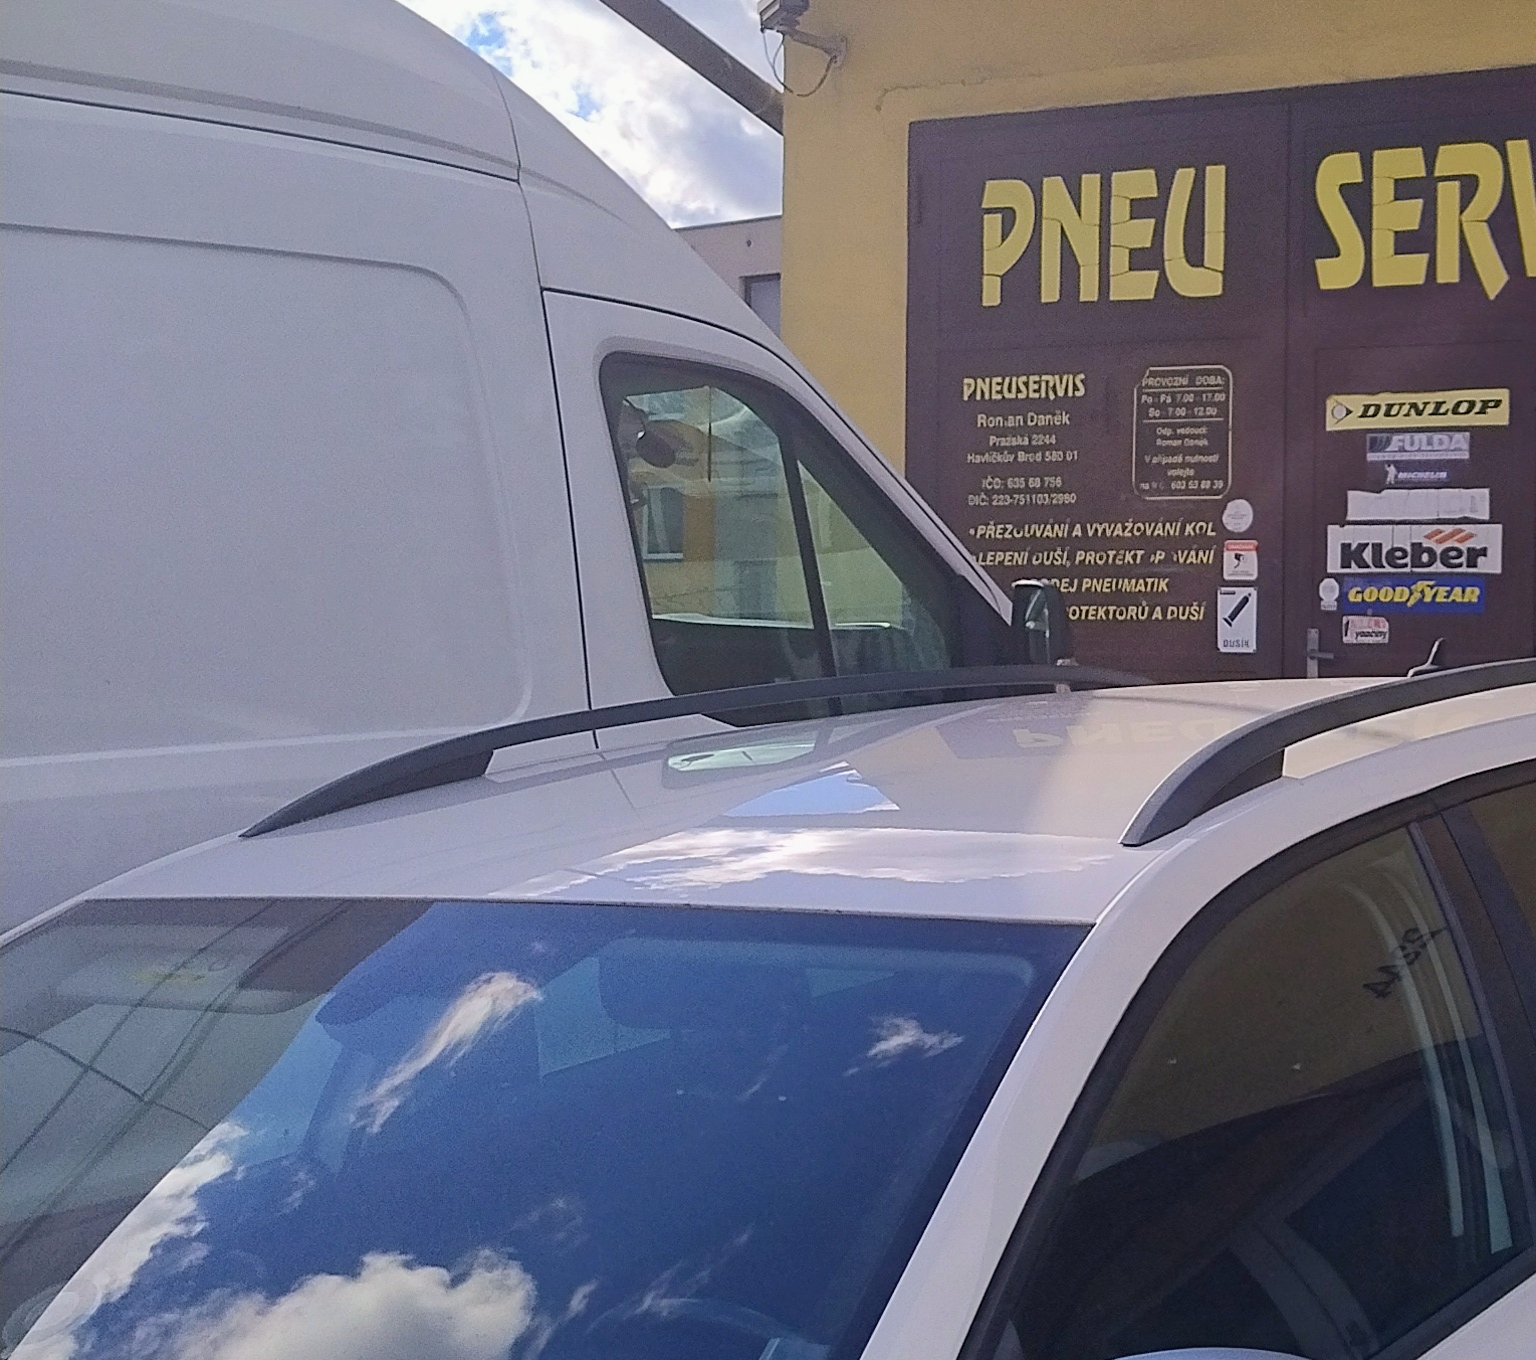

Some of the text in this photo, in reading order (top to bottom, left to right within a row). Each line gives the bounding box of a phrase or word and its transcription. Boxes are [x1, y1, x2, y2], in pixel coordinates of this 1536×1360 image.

[981, 164, 1226, 307] PNEU
[962, 373, 1086, 401] PNEUSERVIS
[1027, 410, 1071, 426] Daněk
[1357, 399, 1503, 419] DUNLOP
[1385, 433, 1469, 451] FULDA
[1066, 450, 1078, 460] 01
[1072, 523, 1082, 537] A
[1086, 517, 1183, 538] VYVAŽOVÁNÍ
[1185, 521, 1217, 537] KOL
[978, 546, 1031, 566] LEPENÍ
[1340, 542, 1488, 570] Kleber
[1081, 578, 1169, 593] PNEUMATIK
[1151, 605, 1163, 621] A
[1167, 601, 1207, 621] DUŠÍ
